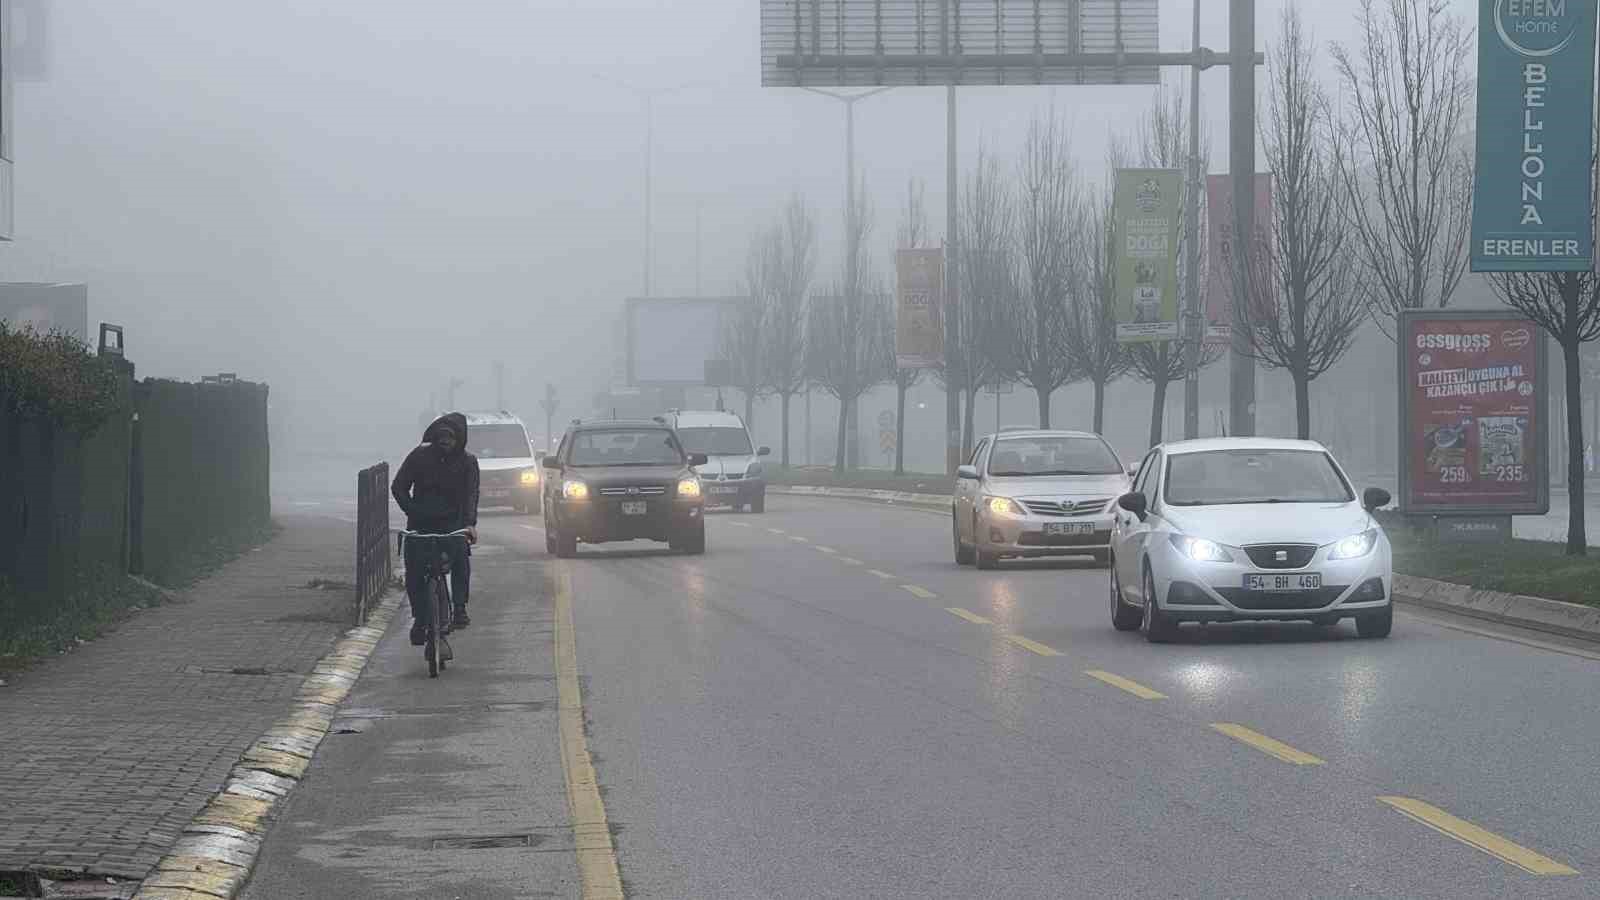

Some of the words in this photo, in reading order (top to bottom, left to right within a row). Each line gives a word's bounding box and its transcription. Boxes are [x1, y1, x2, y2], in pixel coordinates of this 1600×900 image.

[1509, 0, 1566, 16] EFEM
[1521, 63, 1547, 225] BELLONA
[1483, 240, 1579, 256] ERENLER
[1416, 333, 1491, 350] essgross
[1251, 576, 1264, 588] 54
[1275, 576, 1288, 588] BH
[1299, 575, 1319, 588] 460
